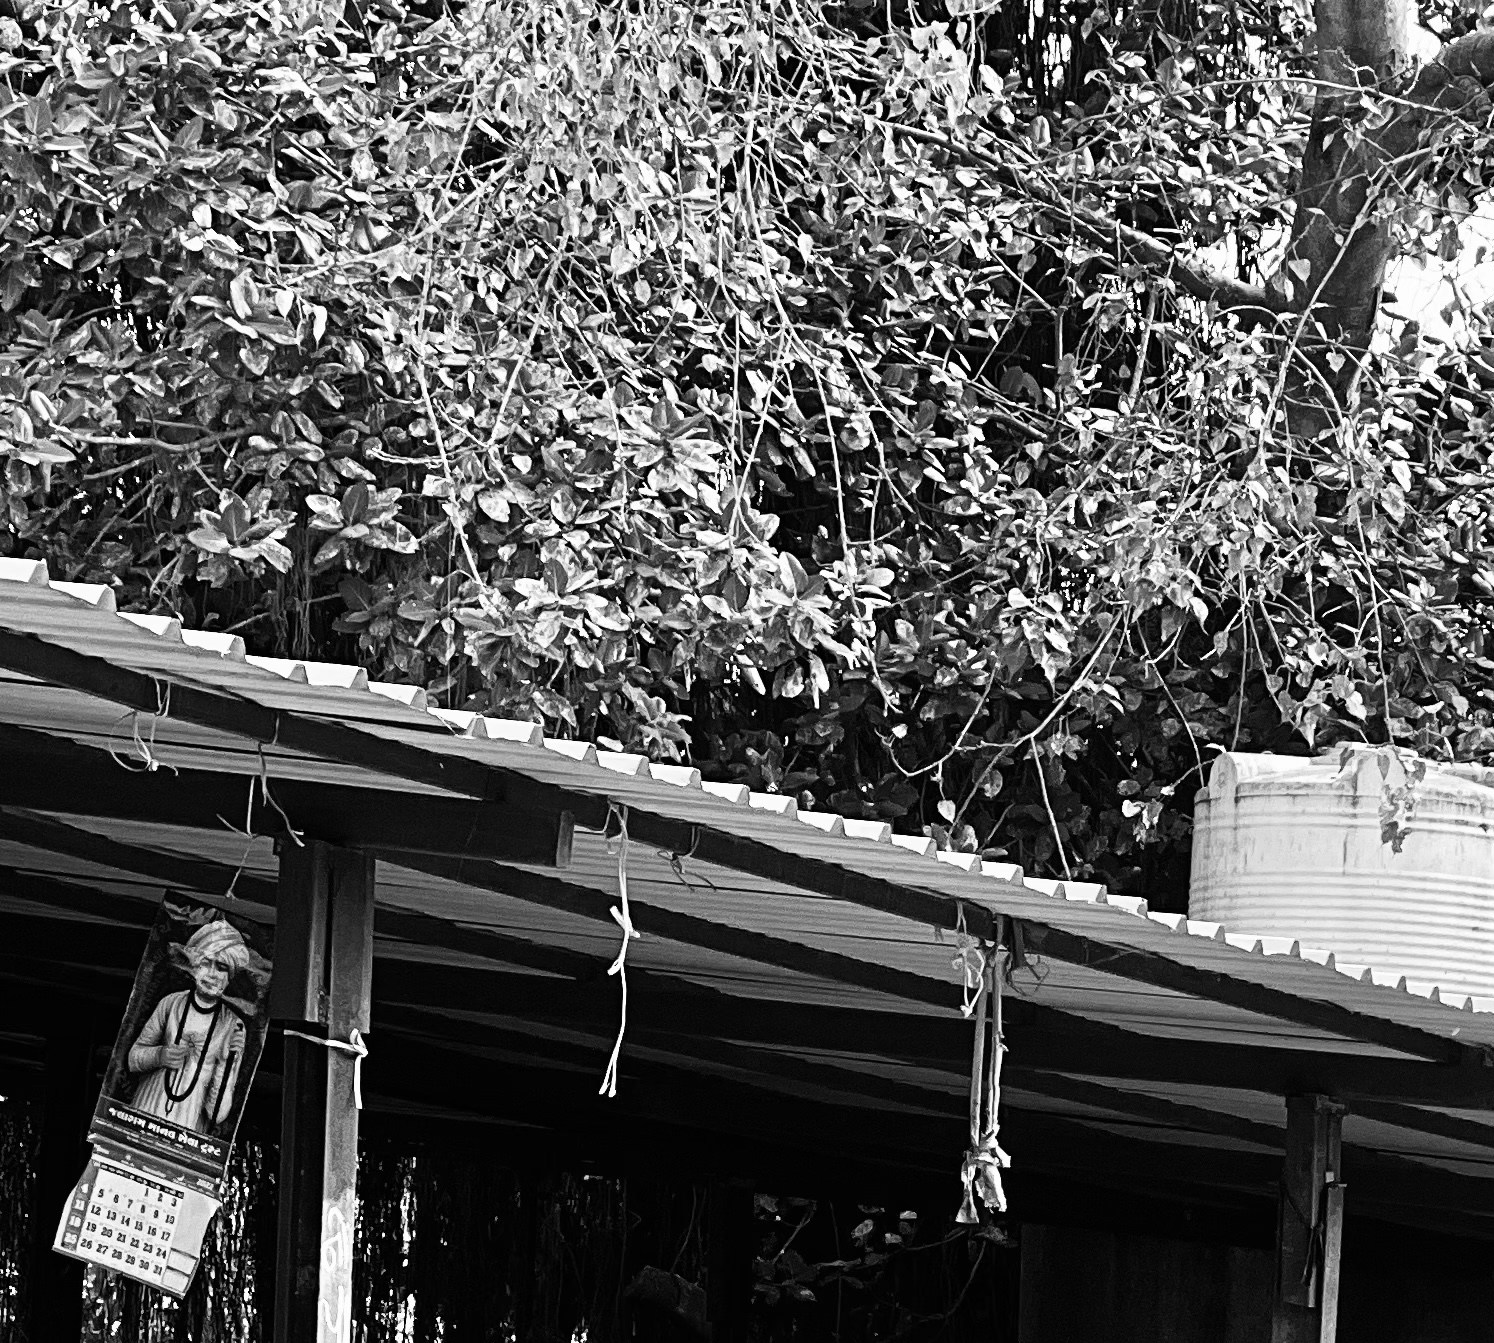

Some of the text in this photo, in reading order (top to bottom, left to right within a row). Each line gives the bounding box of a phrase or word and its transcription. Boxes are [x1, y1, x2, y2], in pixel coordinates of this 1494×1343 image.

[98, 1189, 104, 1198] 5
[114, 1194, 119, 1203] 6
[127, 1199, 133, 1208] 7
[141, 1205, 146, 1213] 8
[153, 1210, 158, 1218] 9
[165, 1214, 174, 1224] 10
[145, 1188, 149, 1197] 1
[157, 1193, 163, 1202] 2
[171, 1198, 177, 1207] 3
[86, 1222, 96, 1232] 19
[101, 1227, 112, 1237] 20
[117, 1233, 126, 1243] 21
[130, 1238, 139, 1248] 22
[143, 1243, 153, 1253] 23
[156, 1248, 166, 1259] 24
[91, 1205, 101, 1216] 12
[107, 1210, 116, 1220] 13
[121, 1216, 130, 1226] 14
[135, 1221, 143, 1231] 15
[148, 1226, 156, 1236] 16
[161, 1231, 170, 1241] 17
[80, 1238, 92, 1249] 26
[96, 1243, 108, 1254] 27
[112, 1249, 122, 1260] 28
[125, 1255, 135, 1265] 29
[139, 1260, 149, 1270] 30
[153, 1265, 162, 1275] 31
